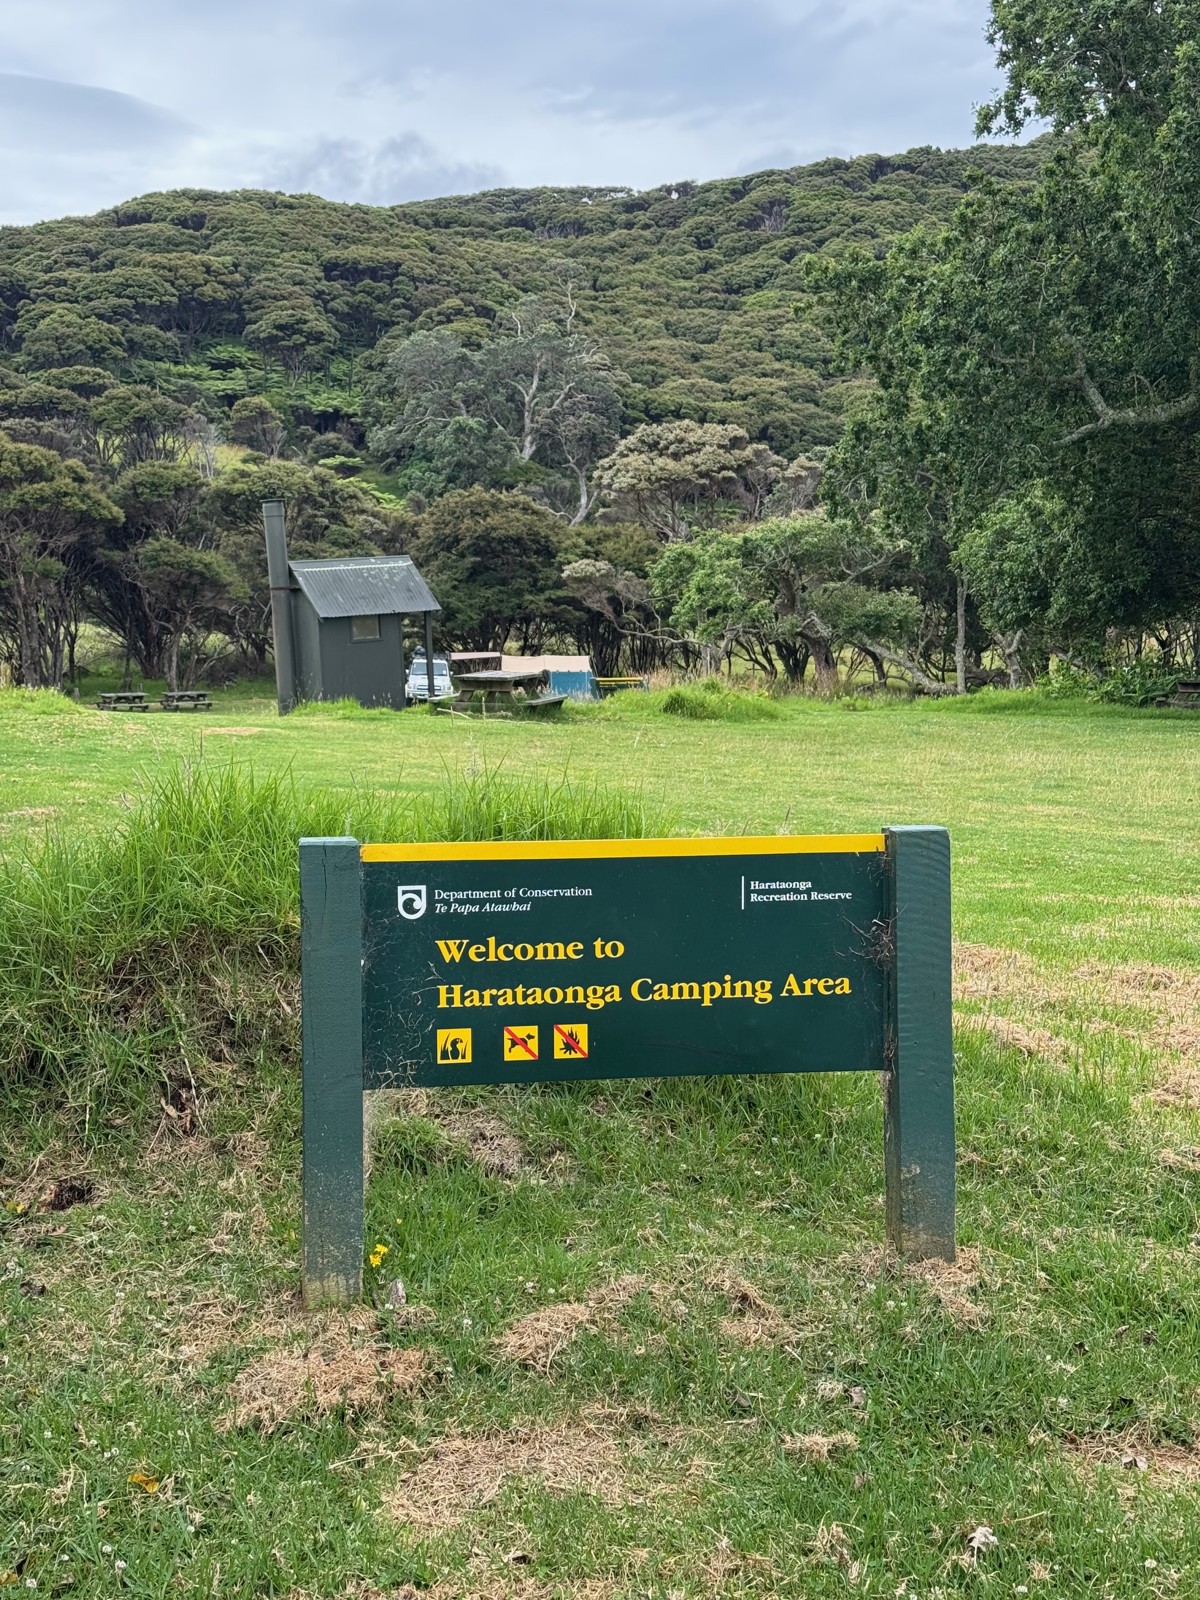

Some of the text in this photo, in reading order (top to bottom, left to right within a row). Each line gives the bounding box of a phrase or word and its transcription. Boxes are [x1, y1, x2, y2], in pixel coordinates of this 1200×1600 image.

[750, 880, 812, 890] Harataonga
[434, 886, 593, 901] Department of Conservation
[750, 891, 853, 902] Recreation Reserve
[434, 901, 532, 915] Te Papa Atawhai
[435, 935, 625, 964] Welcome to
[436, 973, 852, 1009] Harataonga Camping Area
